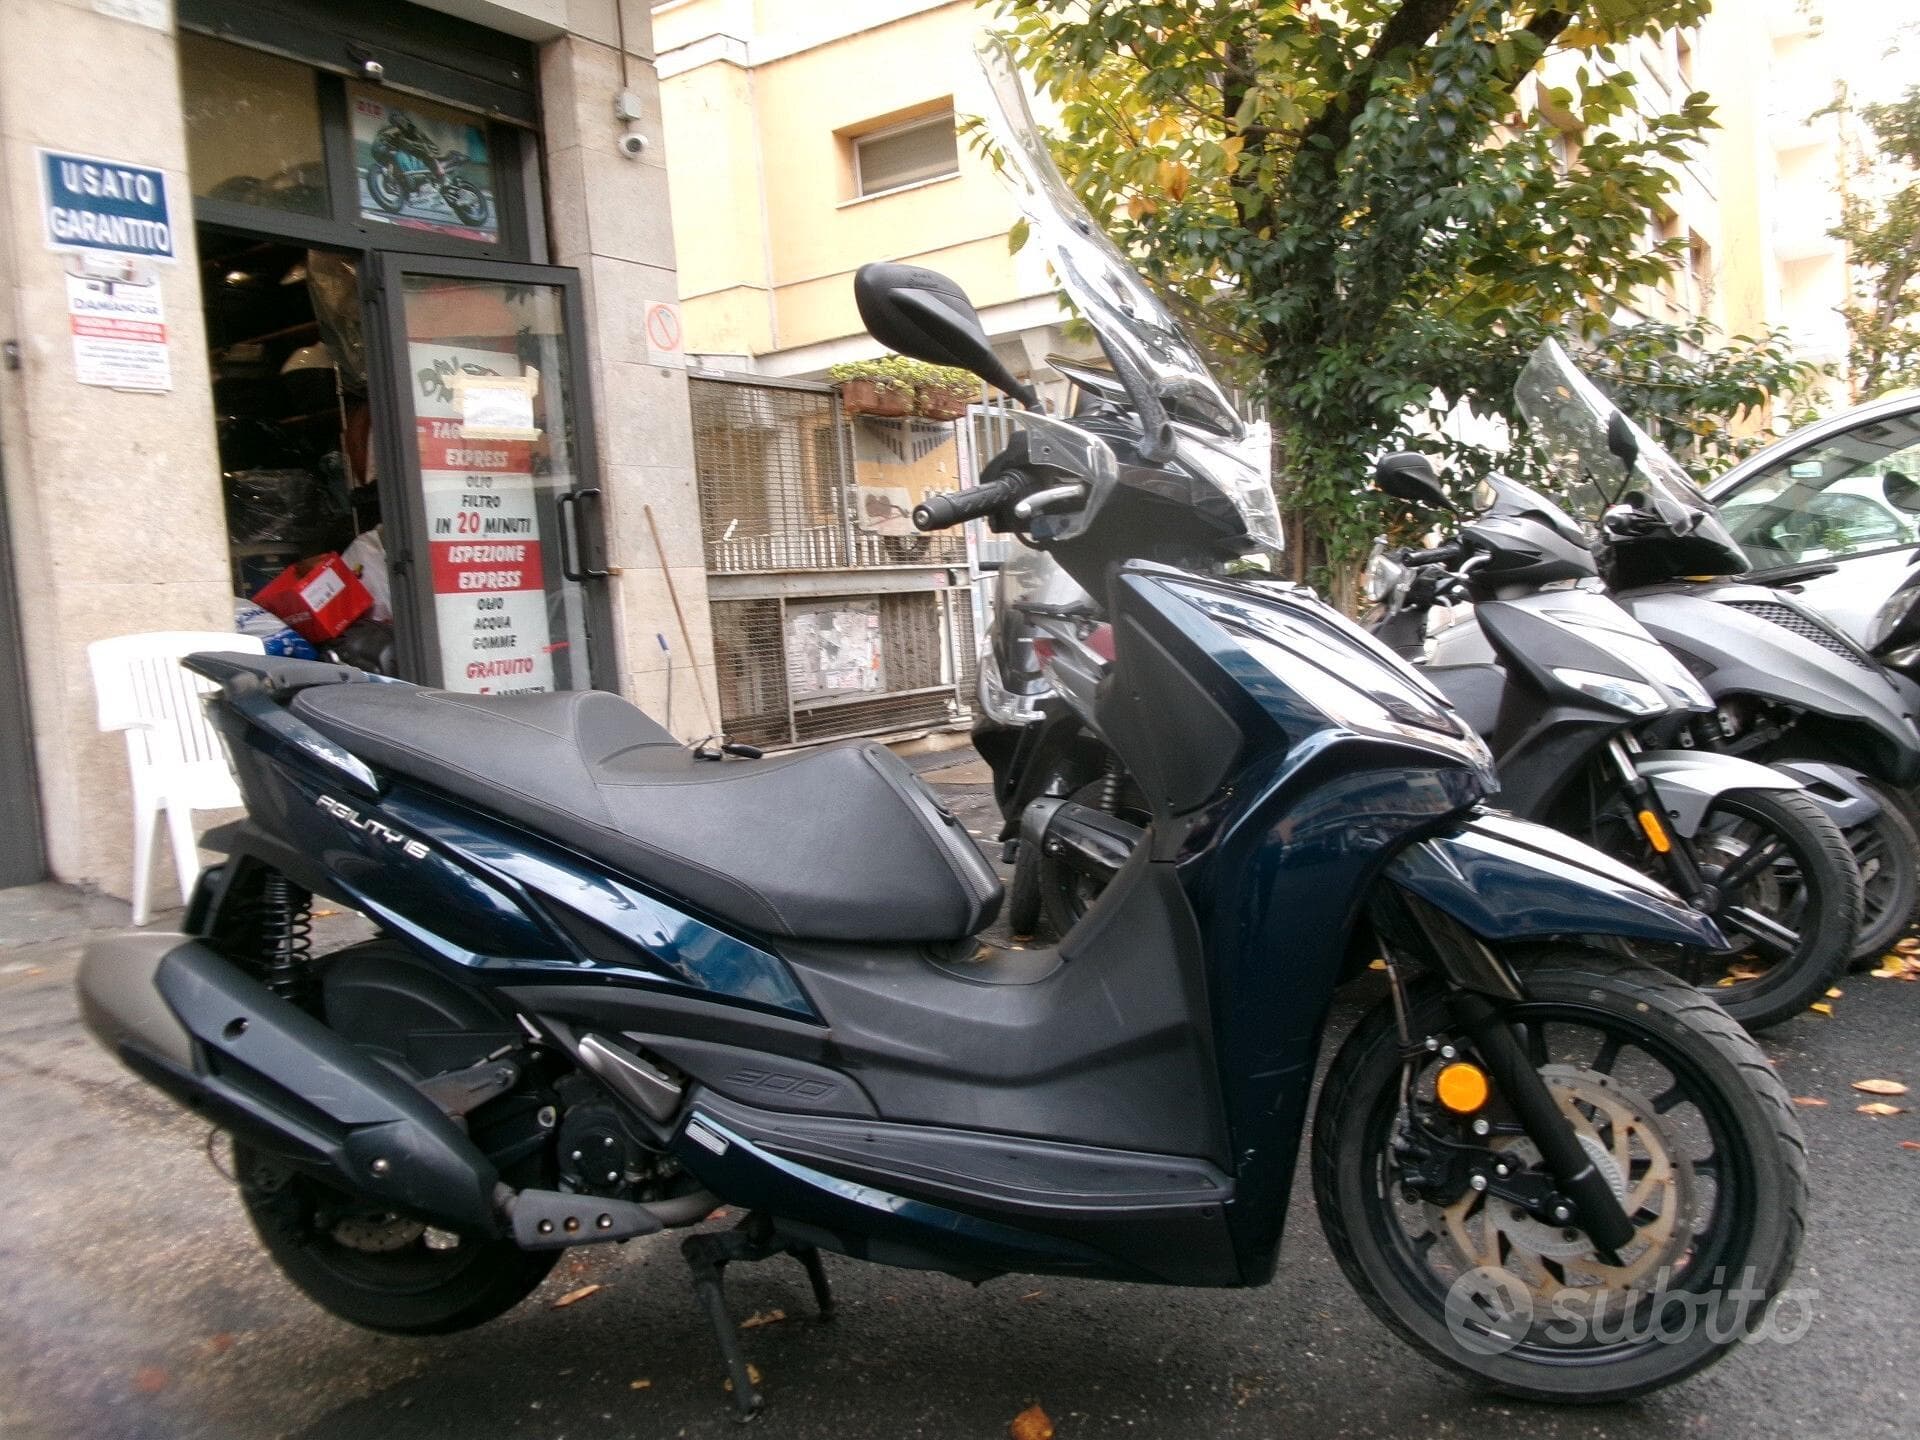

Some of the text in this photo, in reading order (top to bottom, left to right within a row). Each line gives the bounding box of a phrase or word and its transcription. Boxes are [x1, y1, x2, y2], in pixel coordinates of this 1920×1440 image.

[61, 160, 156, 205] USATO
[50, 206, 169, 252] GARANTITO
[445, 448, 508, 467] EXPRESS
[466, 476, 492, 488] OLIO
[462, 495, 501, 508] FILTRO
[435, 511, 530, 533] IN 20 MINUTI
[448, 545, 525, 563] ISPEZIONE
[458, 571, 522, 589] EXPRESS
[477, 597, 504, 610] OLIO
[473, 616, 512, 630] ACQUA
[472, 635, 517, 649] GOMME
[466, 658, 534, 679] GRATUITO
[316, 795, 404, 842] AGILITY
[725, 1068, 835, 1100] 300
